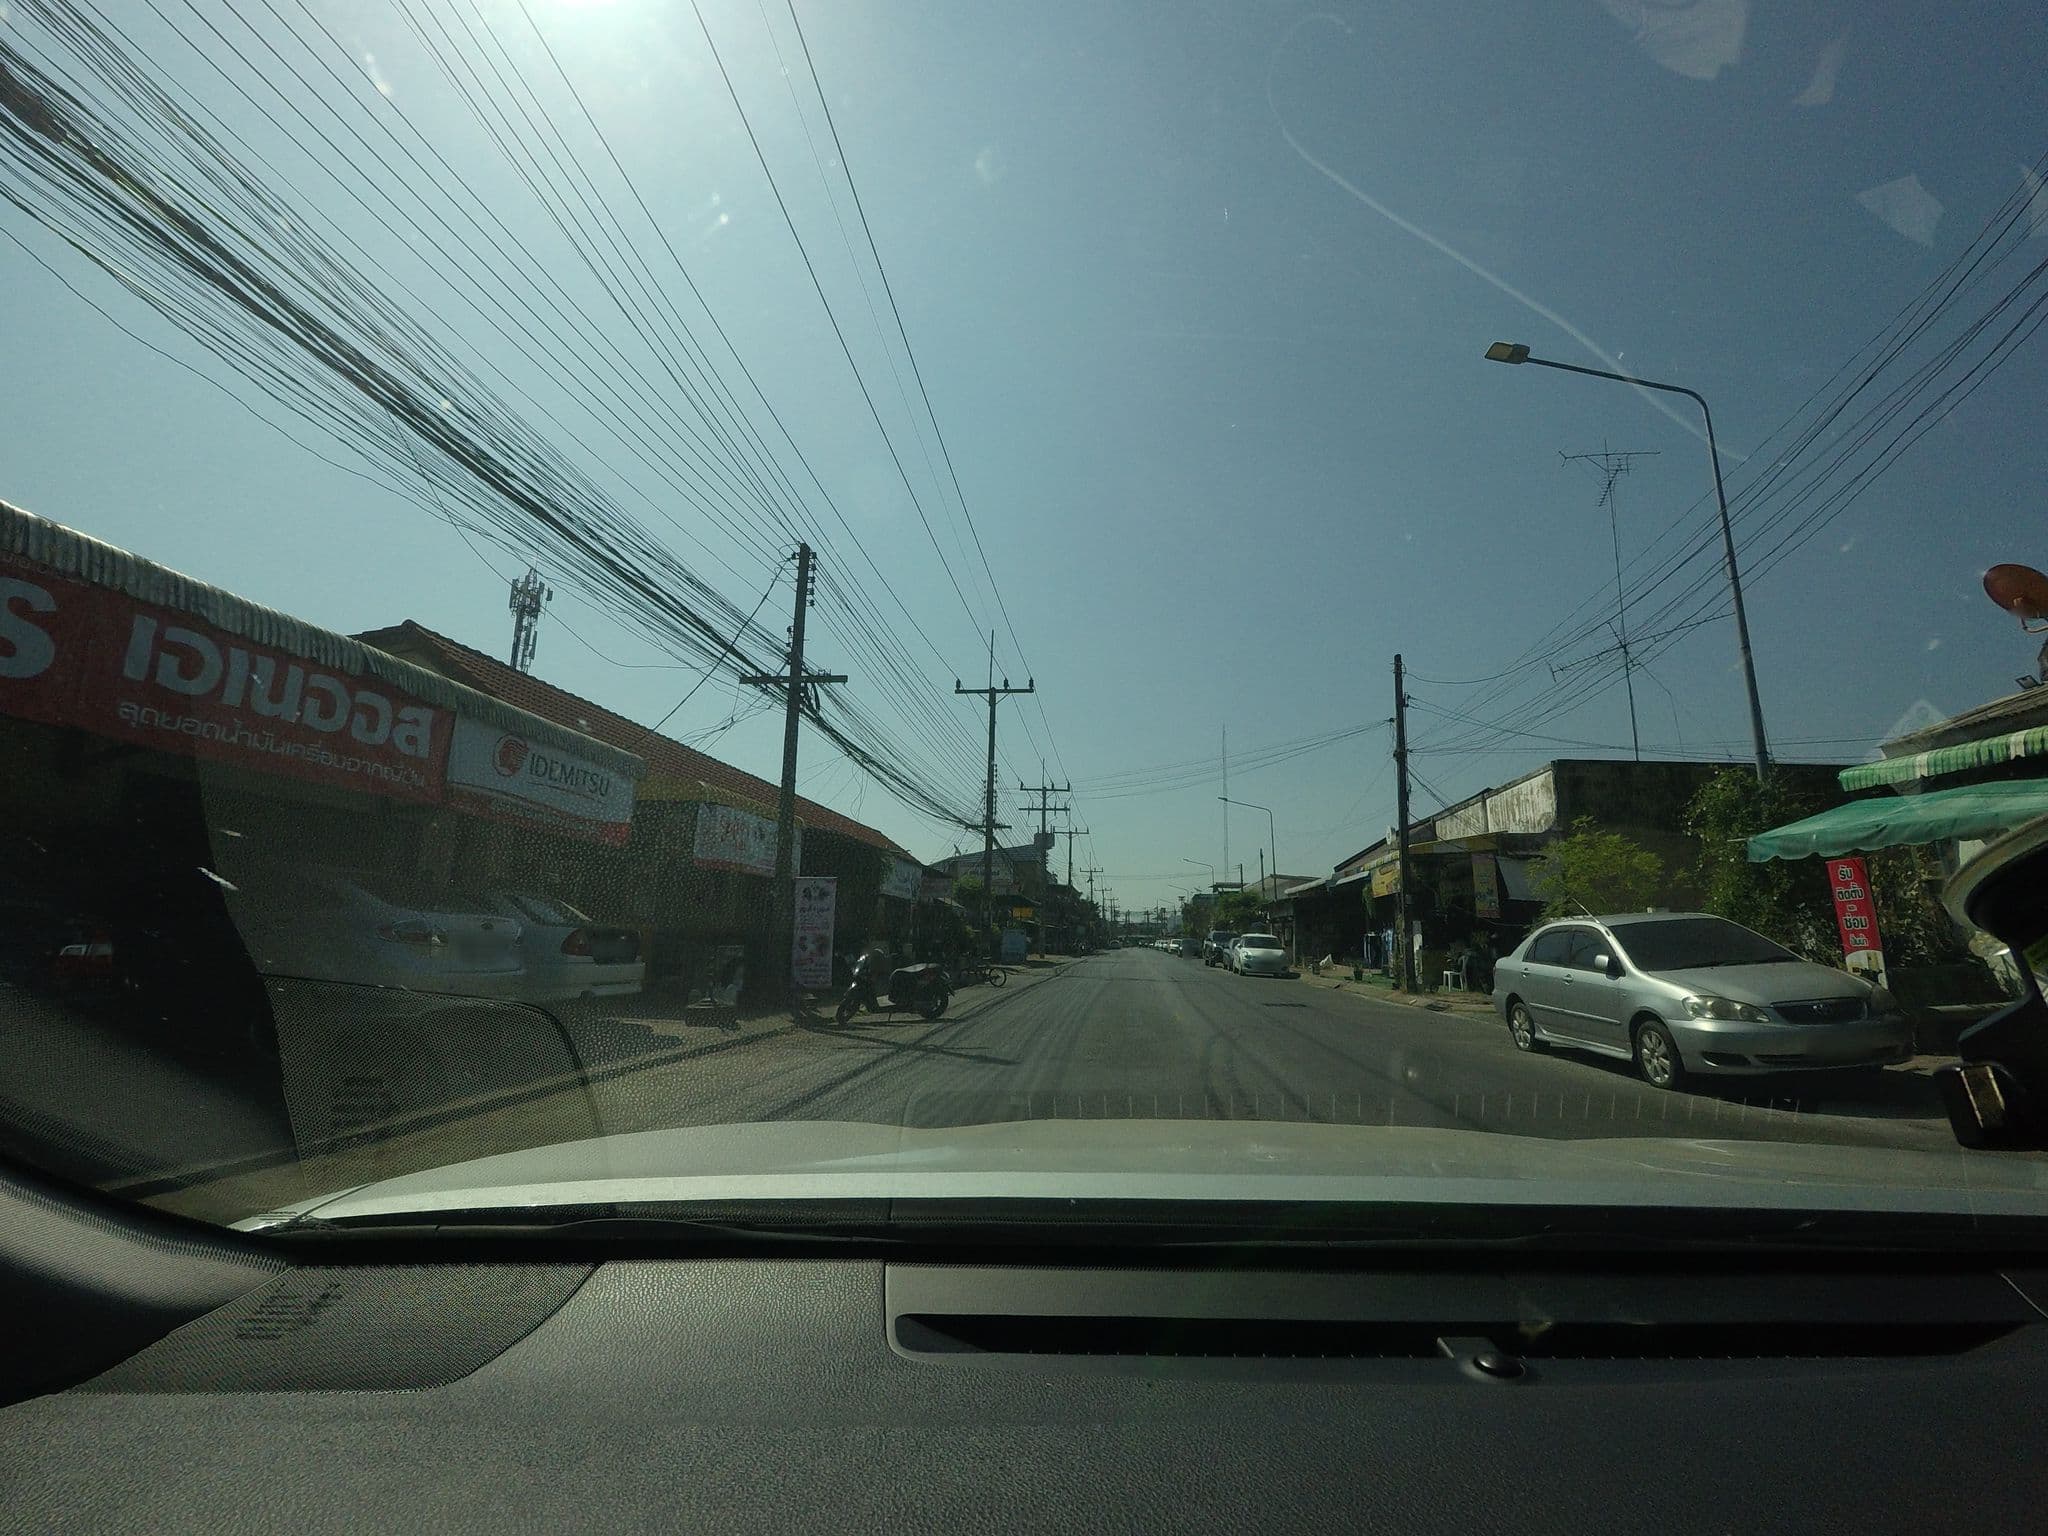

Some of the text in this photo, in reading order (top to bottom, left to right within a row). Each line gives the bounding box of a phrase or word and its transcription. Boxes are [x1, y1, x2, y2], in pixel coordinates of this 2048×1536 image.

[123, 613, 436, 760] เอเนออส
[529, 753, 611, 798] IDEMITSU
[1838, 865, 1853, 881] รับ
